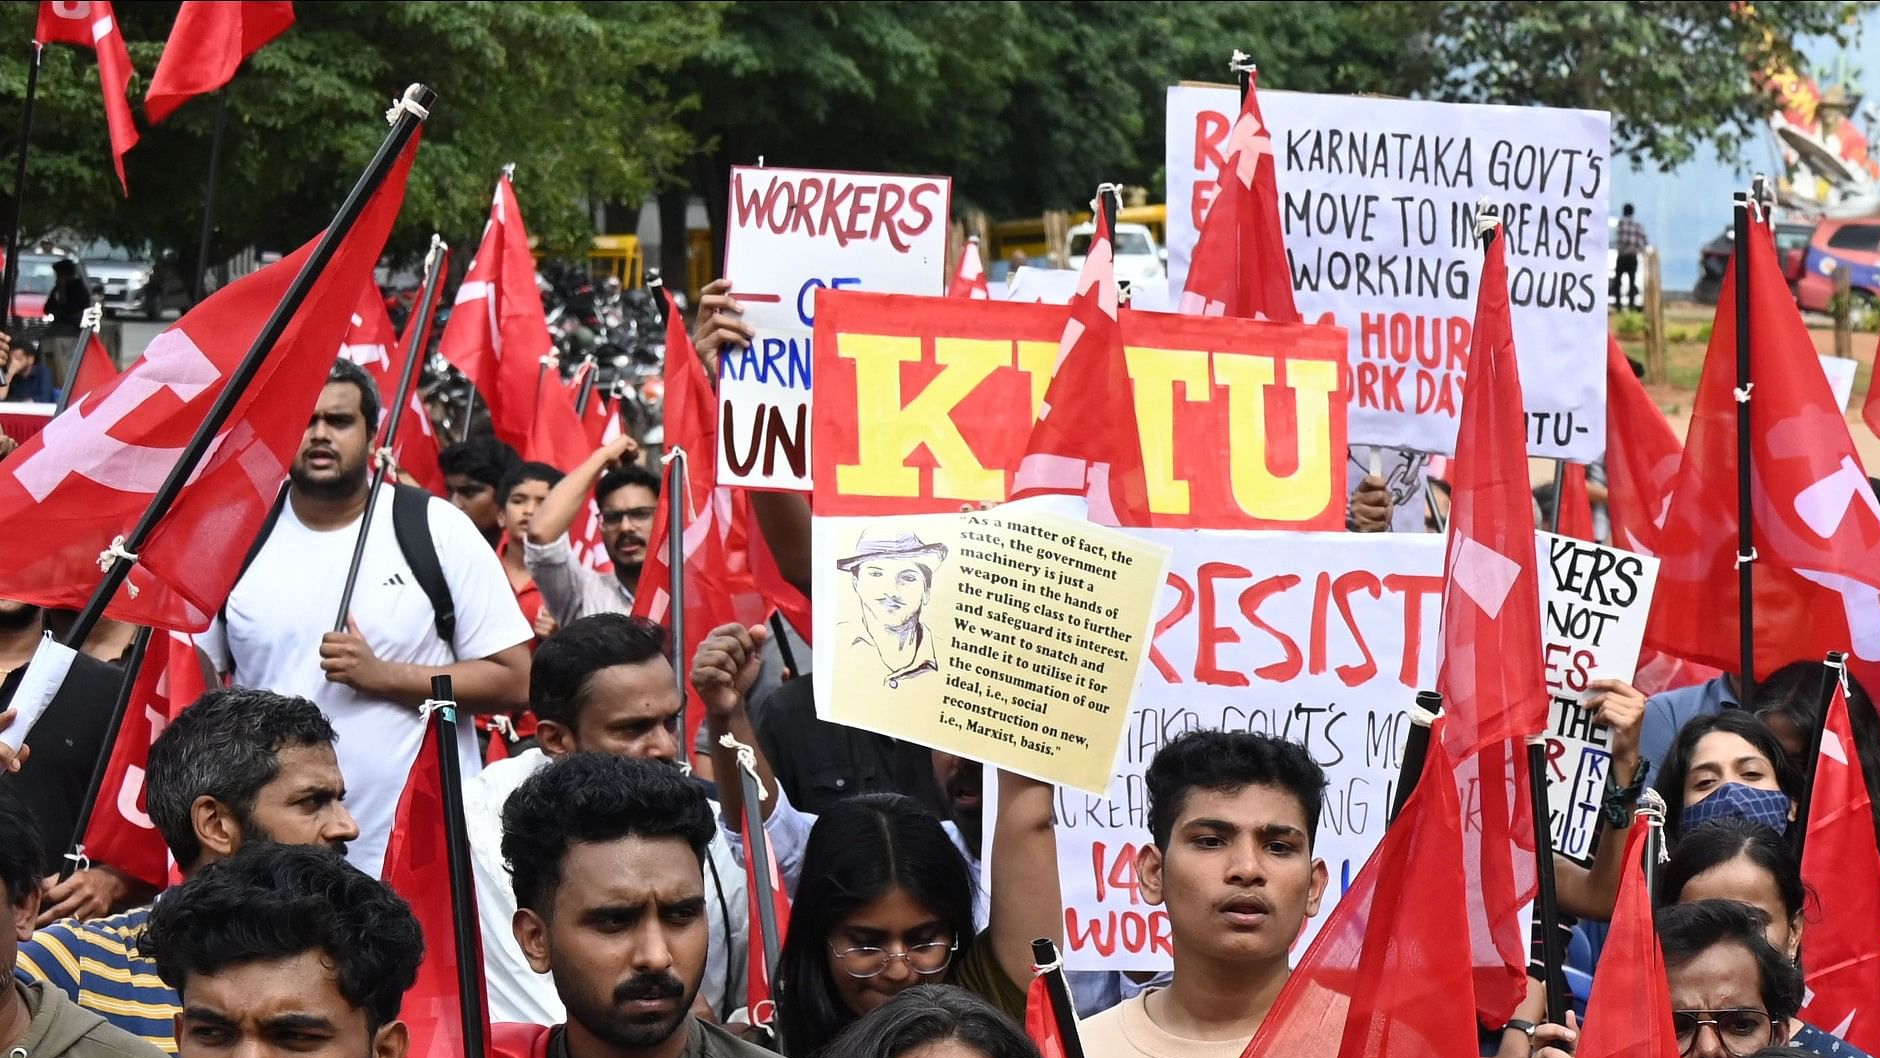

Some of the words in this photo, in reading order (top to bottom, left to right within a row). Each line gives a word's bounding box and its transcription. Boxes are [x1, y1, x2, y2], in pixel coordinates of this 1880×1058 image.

[1286, 129, 1473, 188] KARNATAKA
[1488, 139, 1602, 200] GOVT'S
[735, 173, 940, 253] WORKERS
[1285, 189, 1378, 242] MOVE
[1392, 198, 1436, 247] TO
[1452, 201, 1592, 261] INREASE
[1287, 249, 1468, 299] WORKING
[1507, 266, 1595, 312] OURS
[724, 400, 813, 478] UN
[960, 531, 1005, 549] state,
[1010, 539, 1033, 554] the
[1036, 548, 1117, 581] government
[960, 548, 1041, 577] machinery
[1044, 566, 1056, 580] is
[1058, 571, 1085, 589] just
[1086, 583, 1094, 593] a
[993, 520, 1002, 528] a
[1007, 522, 1059, 542] matter
[1061, 535, 1077, 548] of
[1078, 538, 1107, 561] fact,
[1111, 550, 1133, 566] the
[958, 582, 983, 597] the
[986, 591, 1031, 614] ruling
[1033, 604, 1065, 622] class
[1068, 614, 1081, 627] to
[1084, 618, 1132, 643] further
[959, 565, 1018, 589] weapon
[1021, 579, 1036, 594] in
[1040, 586, 1061, 601] the
[1064, 592, 1103, 614] hands
[1105, 608, 1119, 620] of
[954, 617, 976, 634] We
[980, 627, 1017, 646] want
[1020, 638, 1033, 651] to
[1035, 645, 1078, 666] snatch
[1080, 659, 1105, 674] and
[955, 602, 983, 617] and
[986, 610, 1054, 638] safeguard
[1055, 628, 1073, 644] its
[1075, 634, 1128, 662] interest.
[1148, 562, 1443, 686] RESIST
[1547, 601, 1619, 646] NOT
[945, 673, 982, 697] ideal,
[985, 685, 1008, 706] i.e.,
[1011, 696, 1048, 715] social
[949, 656, 972, 672] the
[975, 665, 1070, 702] consummation
[1072, 695, 1087, 707] of
[1088, 701, 1110, 714] our
[951, 636, 999, 660] handle
[1002, 650, 1013, 665] it
[1016, 656, 1029, 669] to
[1032, 663, 1073, 683] utilise
[1075, 673, 1086, 687] it
[1088, 678, 1108, 694] for
[939, 710, 962, 731] i.e.,
[966, 718, 1017, 748] Marxist,
[1020, 735, 1061, 756] basis."
[942, 695, 1039, 732] reconstruction
[1041, 725, 1058, 738] on
[1060, 731, 1089, 750] new,
[1569, 754, 1604, 854] KITU
[1092, 841, 1140, 905] 14
